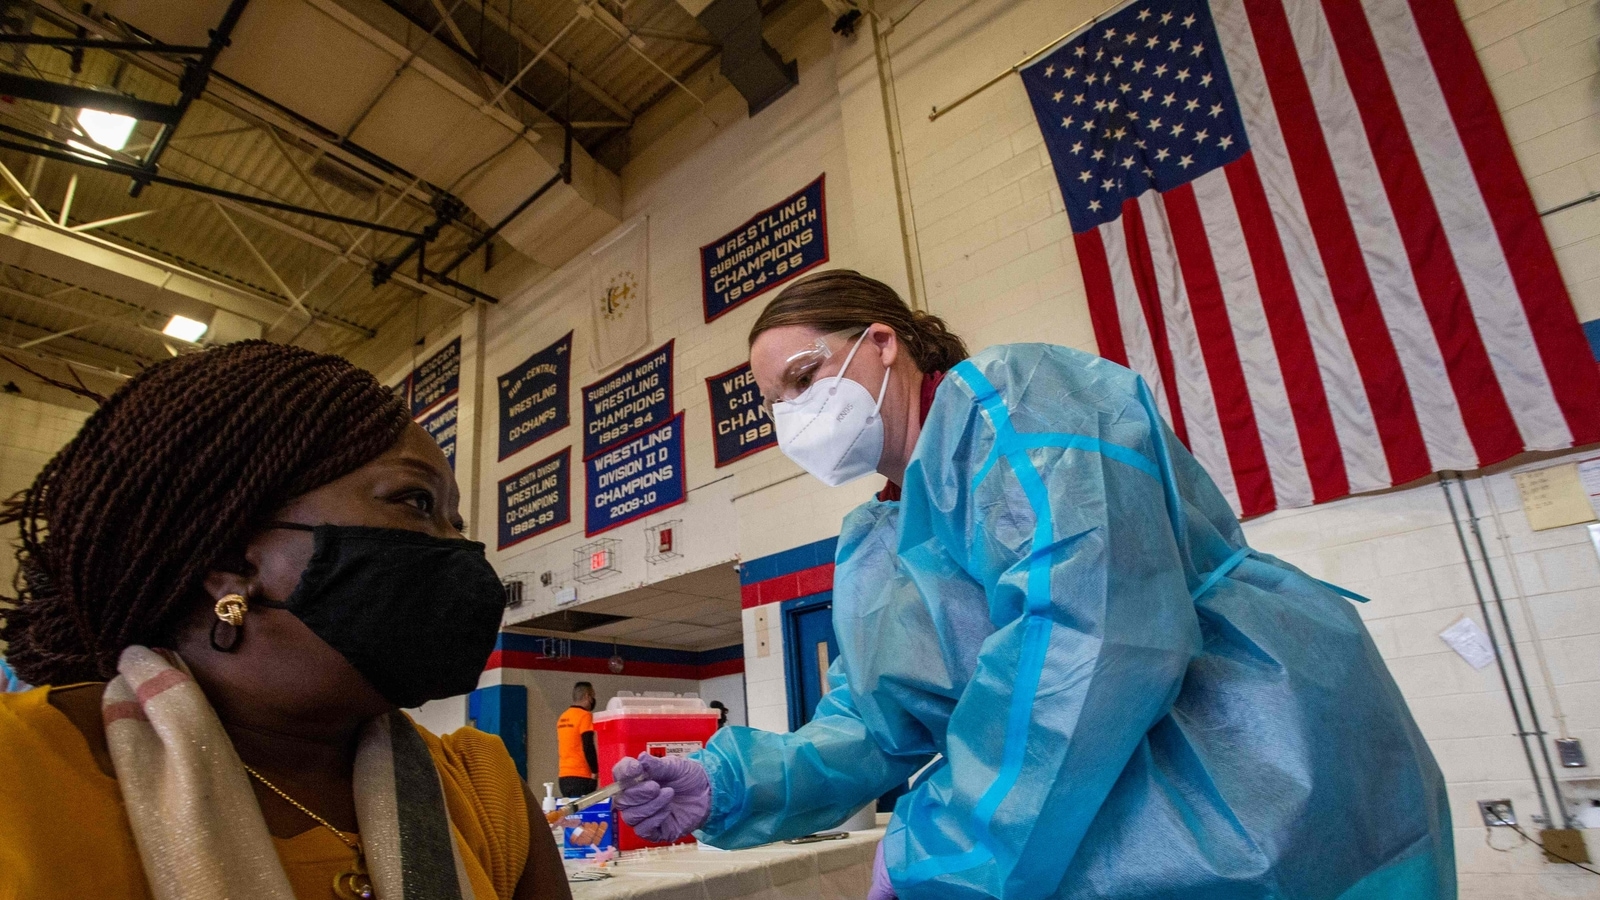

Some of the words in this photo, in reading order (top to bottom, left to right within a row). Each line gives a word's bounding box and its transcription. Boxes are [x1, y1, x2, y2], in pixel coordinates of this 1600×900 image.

[709, 235, 769, 278] SUBURBAN
[774, 208, 817, 241] NORTH
[716, 195, 807, 259] WRESTLING
[714, 228, 813, 293] CHAMPIONS
[724, 252, 803, 304] 1984-85
[588, 371, 632, 401] SUBURBAN
[635, 353, 667, 378] NORTH
[594, 373, 659, 415] WRESTLING
[508, 383, 557, 418] WRESTLING
[589, 387, 665, 434] CHAMPIONS
[729, 390, 754, 410] C-II
[836, 403, 854, 422] KN95
[509, 406, 556, 442] CO-CHAMPS
[599, 412, 653, 444] 1983-84
[594, 425, 672, 472] WRESTLING
[599, 457, 643, 488] DIVISION
[645, 451, 656, 468] II
[658, 446, 668, 462] D
[507, 474, 557, 507] WRESTLING
[519, 471, 536, 487] SOUTH
[537, 459, 560, 478] DIVISION
[594, 464, 673, 508] CHAMPIONS
[506, 491, 559, 524] CO-CHAMPIONS
[510, 510, 554, 536] 1982-83
[610, 491, 657, 518] 2009-10
